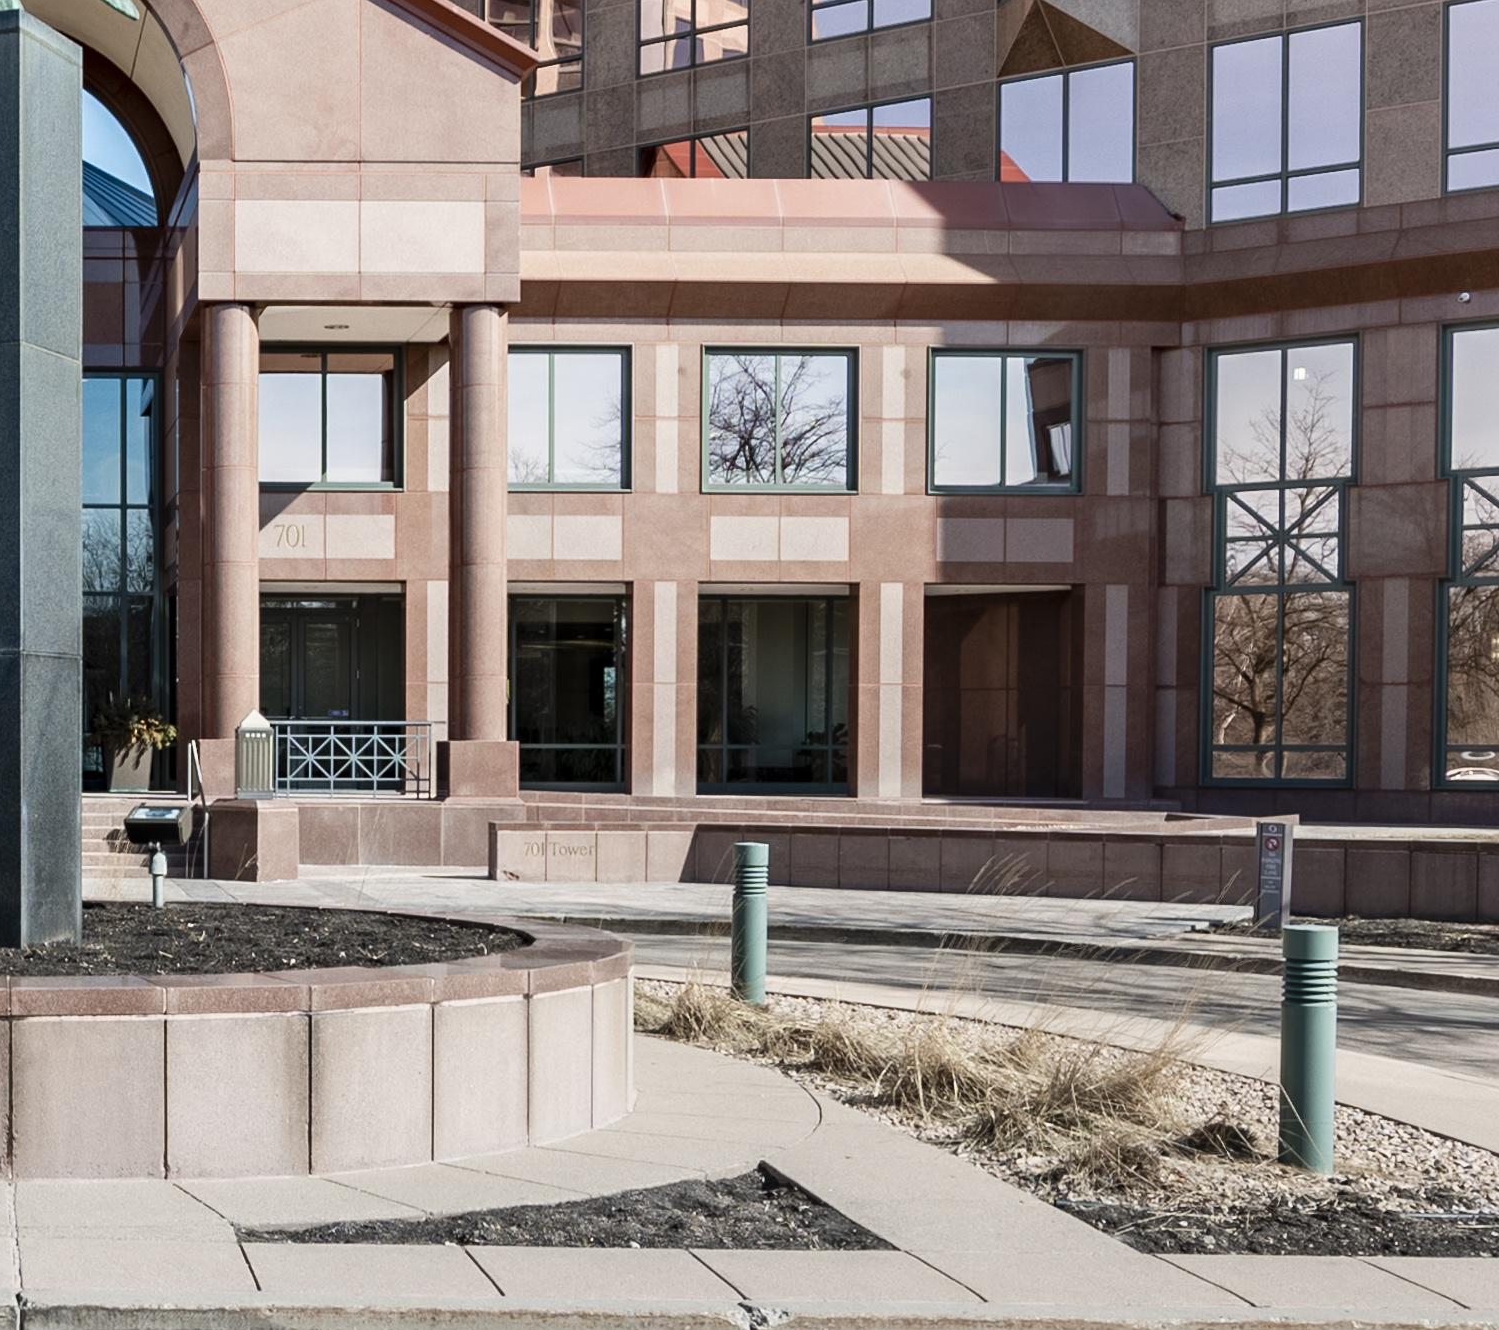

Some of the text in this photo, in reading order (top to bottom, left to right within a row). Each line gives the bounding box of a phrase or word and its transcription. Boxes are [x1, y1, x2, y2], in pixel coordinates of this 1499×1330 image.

[274, 523, 306, 548] 701
[524, 841, 595, 857] 701 Tower
